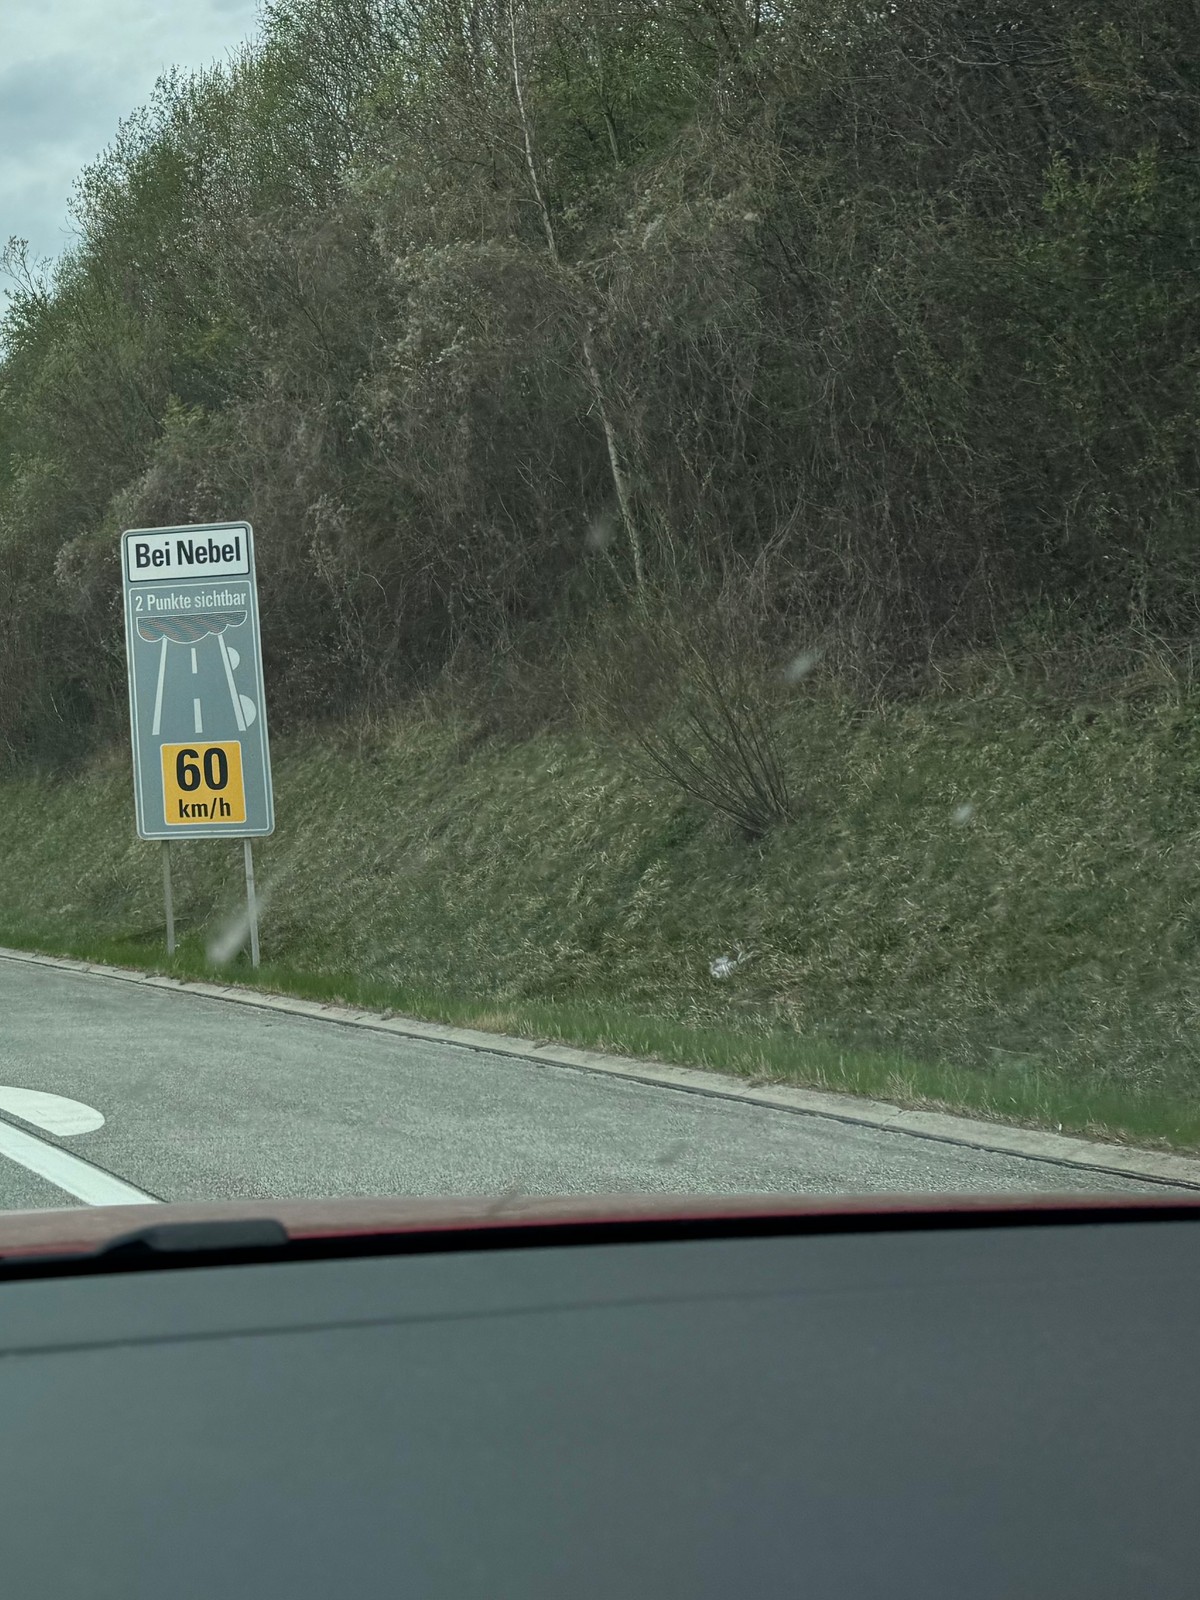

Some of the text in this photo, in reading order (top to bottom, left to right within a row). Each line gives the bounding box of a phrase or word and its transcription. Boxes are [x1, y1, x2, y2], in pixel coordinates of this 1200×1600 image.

[135, 536, 241, 568] Bei Nebel
[135, 589, 246, 612] 2 Punkte sichtbar
[176, 747, 228, 791] 60
[179, 797, 231, 819] km/h
